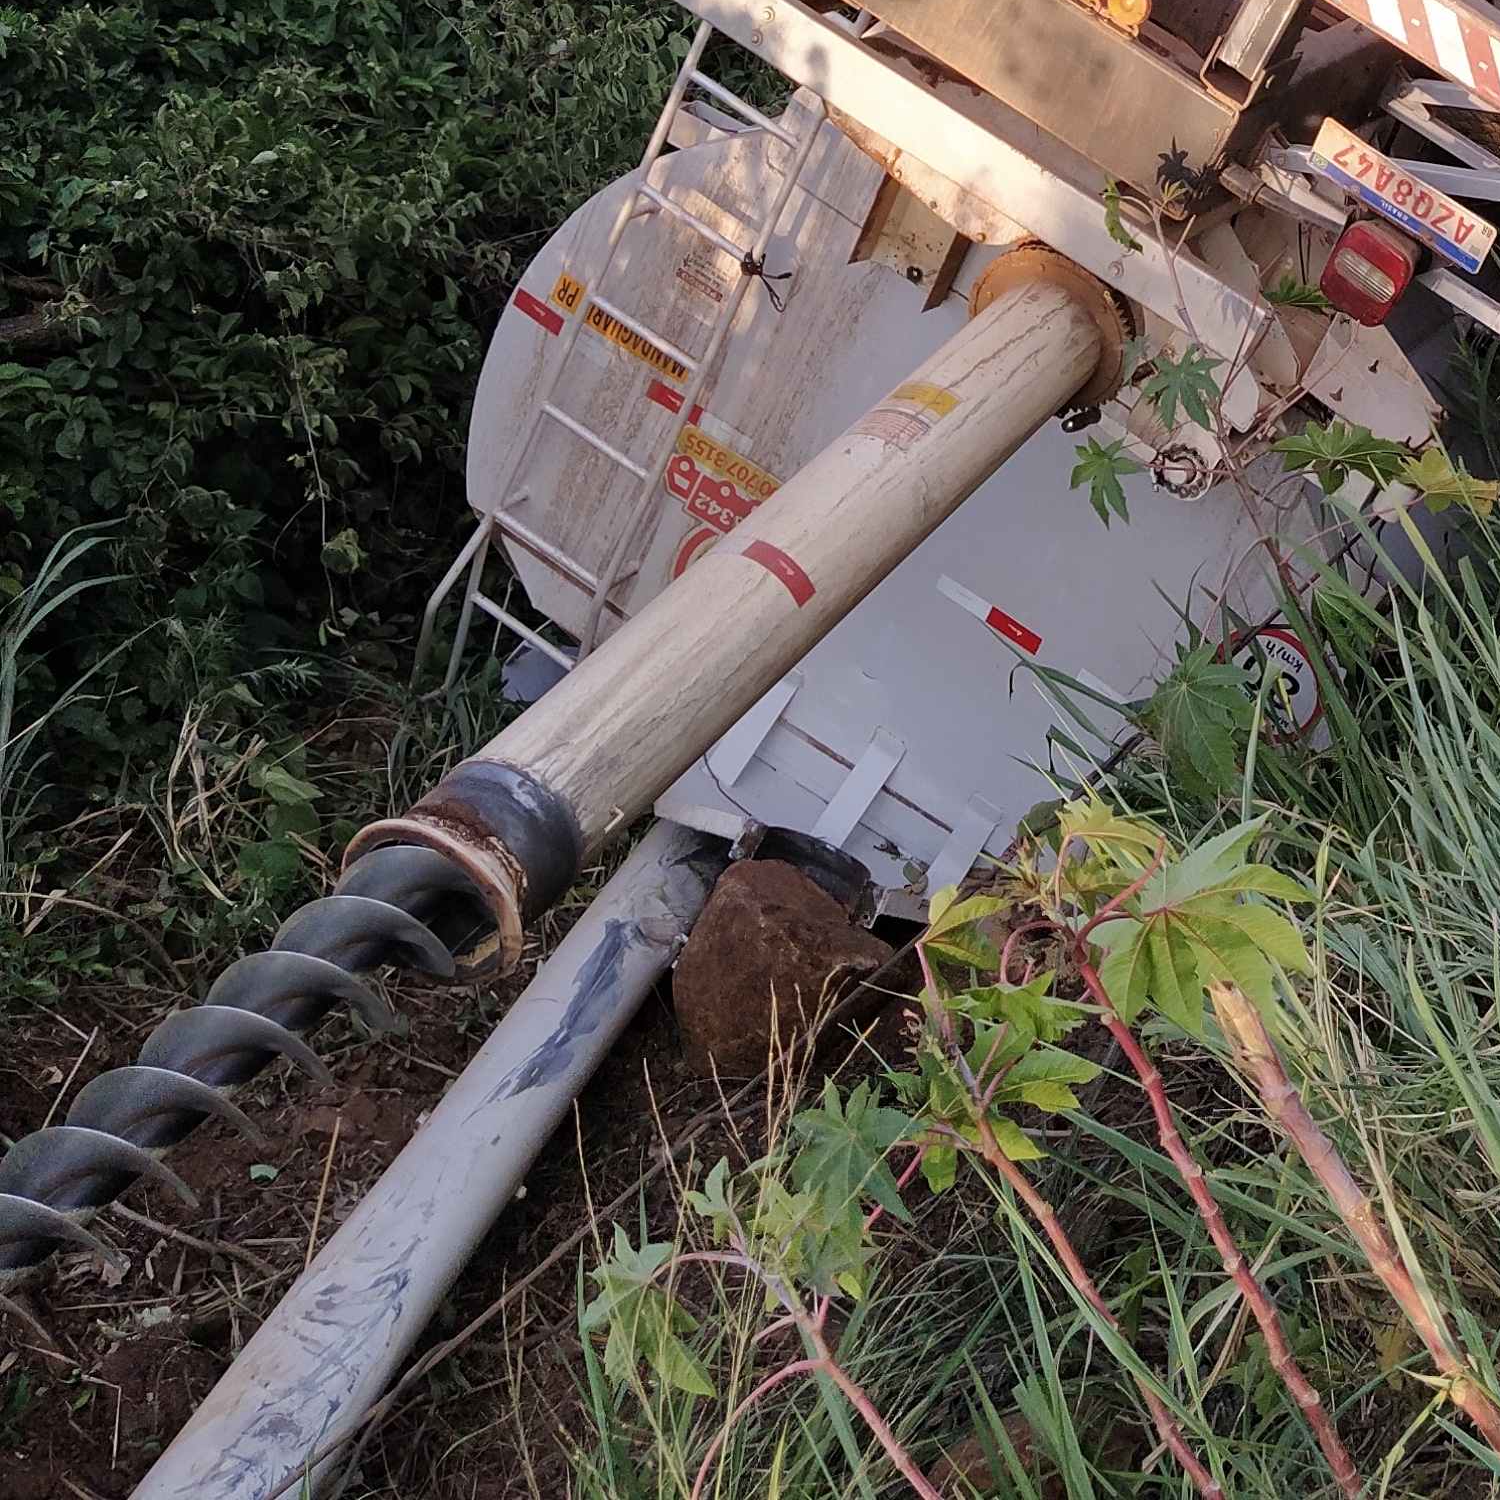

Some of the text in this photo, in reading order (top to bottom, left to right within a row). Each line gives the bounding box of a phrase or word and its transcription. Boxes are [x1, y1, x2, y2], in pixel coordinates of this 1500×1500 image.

[1333, 144, 1476, 244] AZQ8A47
[1380, 200, 1410, 221] BRASIL
[557, 278, 580, 308] PR
[684, 433, 728, 467] 3155
[726, 464, 757, 491] 707
